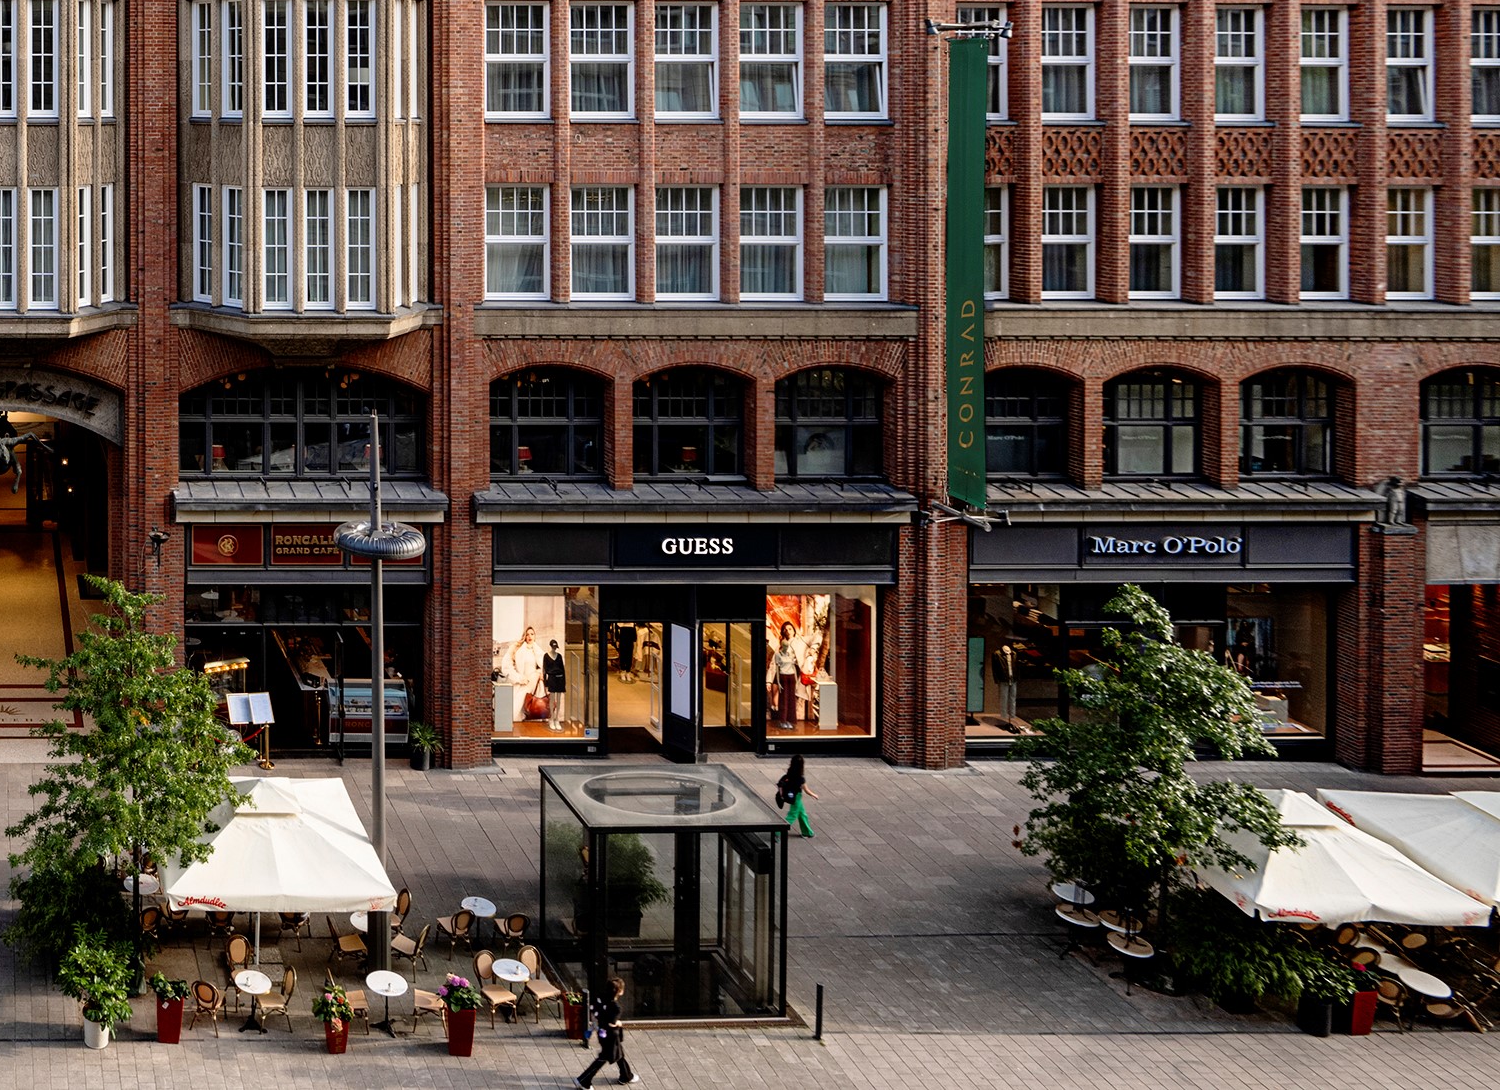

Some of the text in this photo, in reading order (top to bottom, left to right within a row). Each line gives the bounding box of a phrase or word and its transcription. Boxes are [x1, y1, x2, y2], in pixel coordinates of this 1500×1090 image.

[959, 300, 975, 448] CONRAD
[275, 535, 336, 545] RONCALL
[661, 537, 734, 555] GUESS
[1089, 536, 1156, 553] Marc
[276, 547, 310, 555] GRAND
[177, 896, 227, 909] Almdudler
